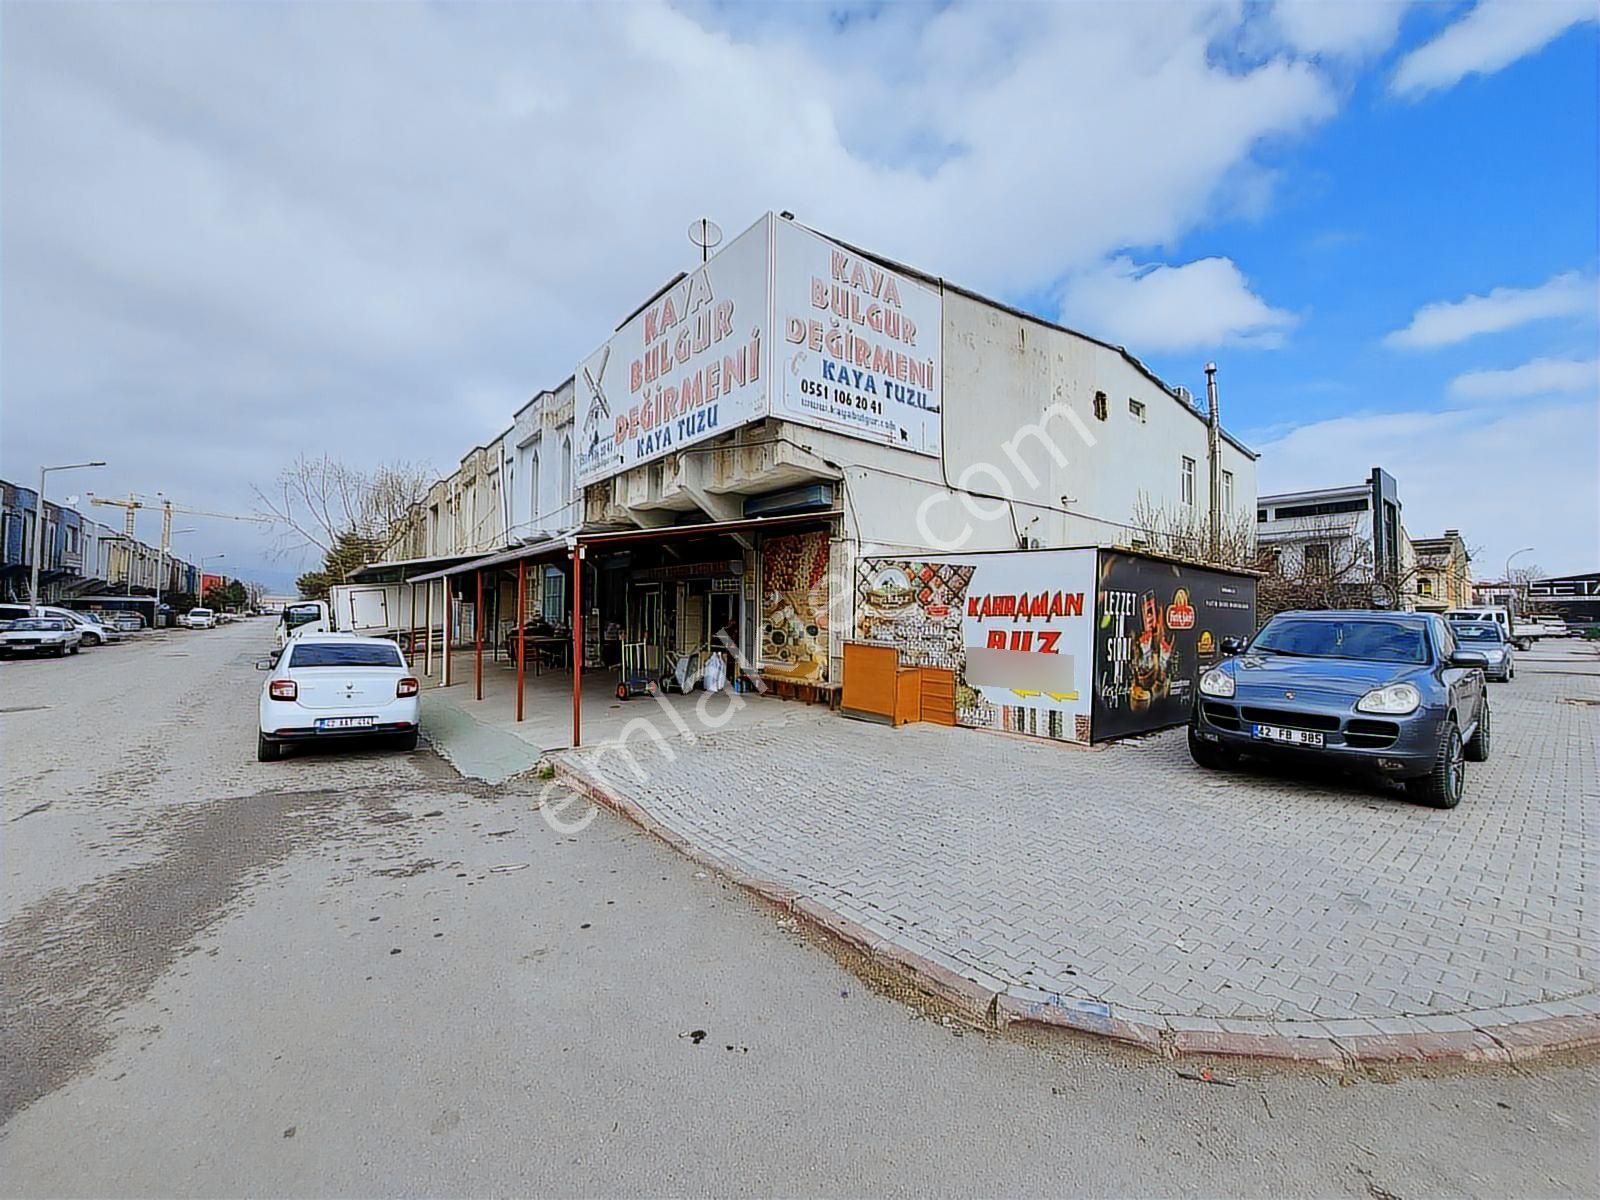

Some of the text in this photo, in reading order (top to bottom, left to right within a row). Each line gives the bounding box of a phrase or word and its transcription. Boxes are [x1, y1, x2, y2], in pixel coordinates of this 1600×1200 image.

[644, 268, 714, 345] KAYA
[831, 249, 902, 309] KAYA
[811, 274, 918, 347] BULGUR
[630, 299, 734, 394] BULGUR
[784, 314, 935, 391] DEĞİRMENİ
[614, 326, 761, 446] DEĞİRMENİ
[800, 378, 883, 415] 0551 106 20 41
[822, 358, 927, 411] KAYA TUZU
[636, 424, 672, 459] KAYA
[676, 403, 719, 441] TUZU
[967, 591, 1084, 623] KAHRAMAN
[1104, 590, 1137, 617] LEZZET
[1258, 726, 1272, 737] 42
[1278, 729, 1293, 740] FB
